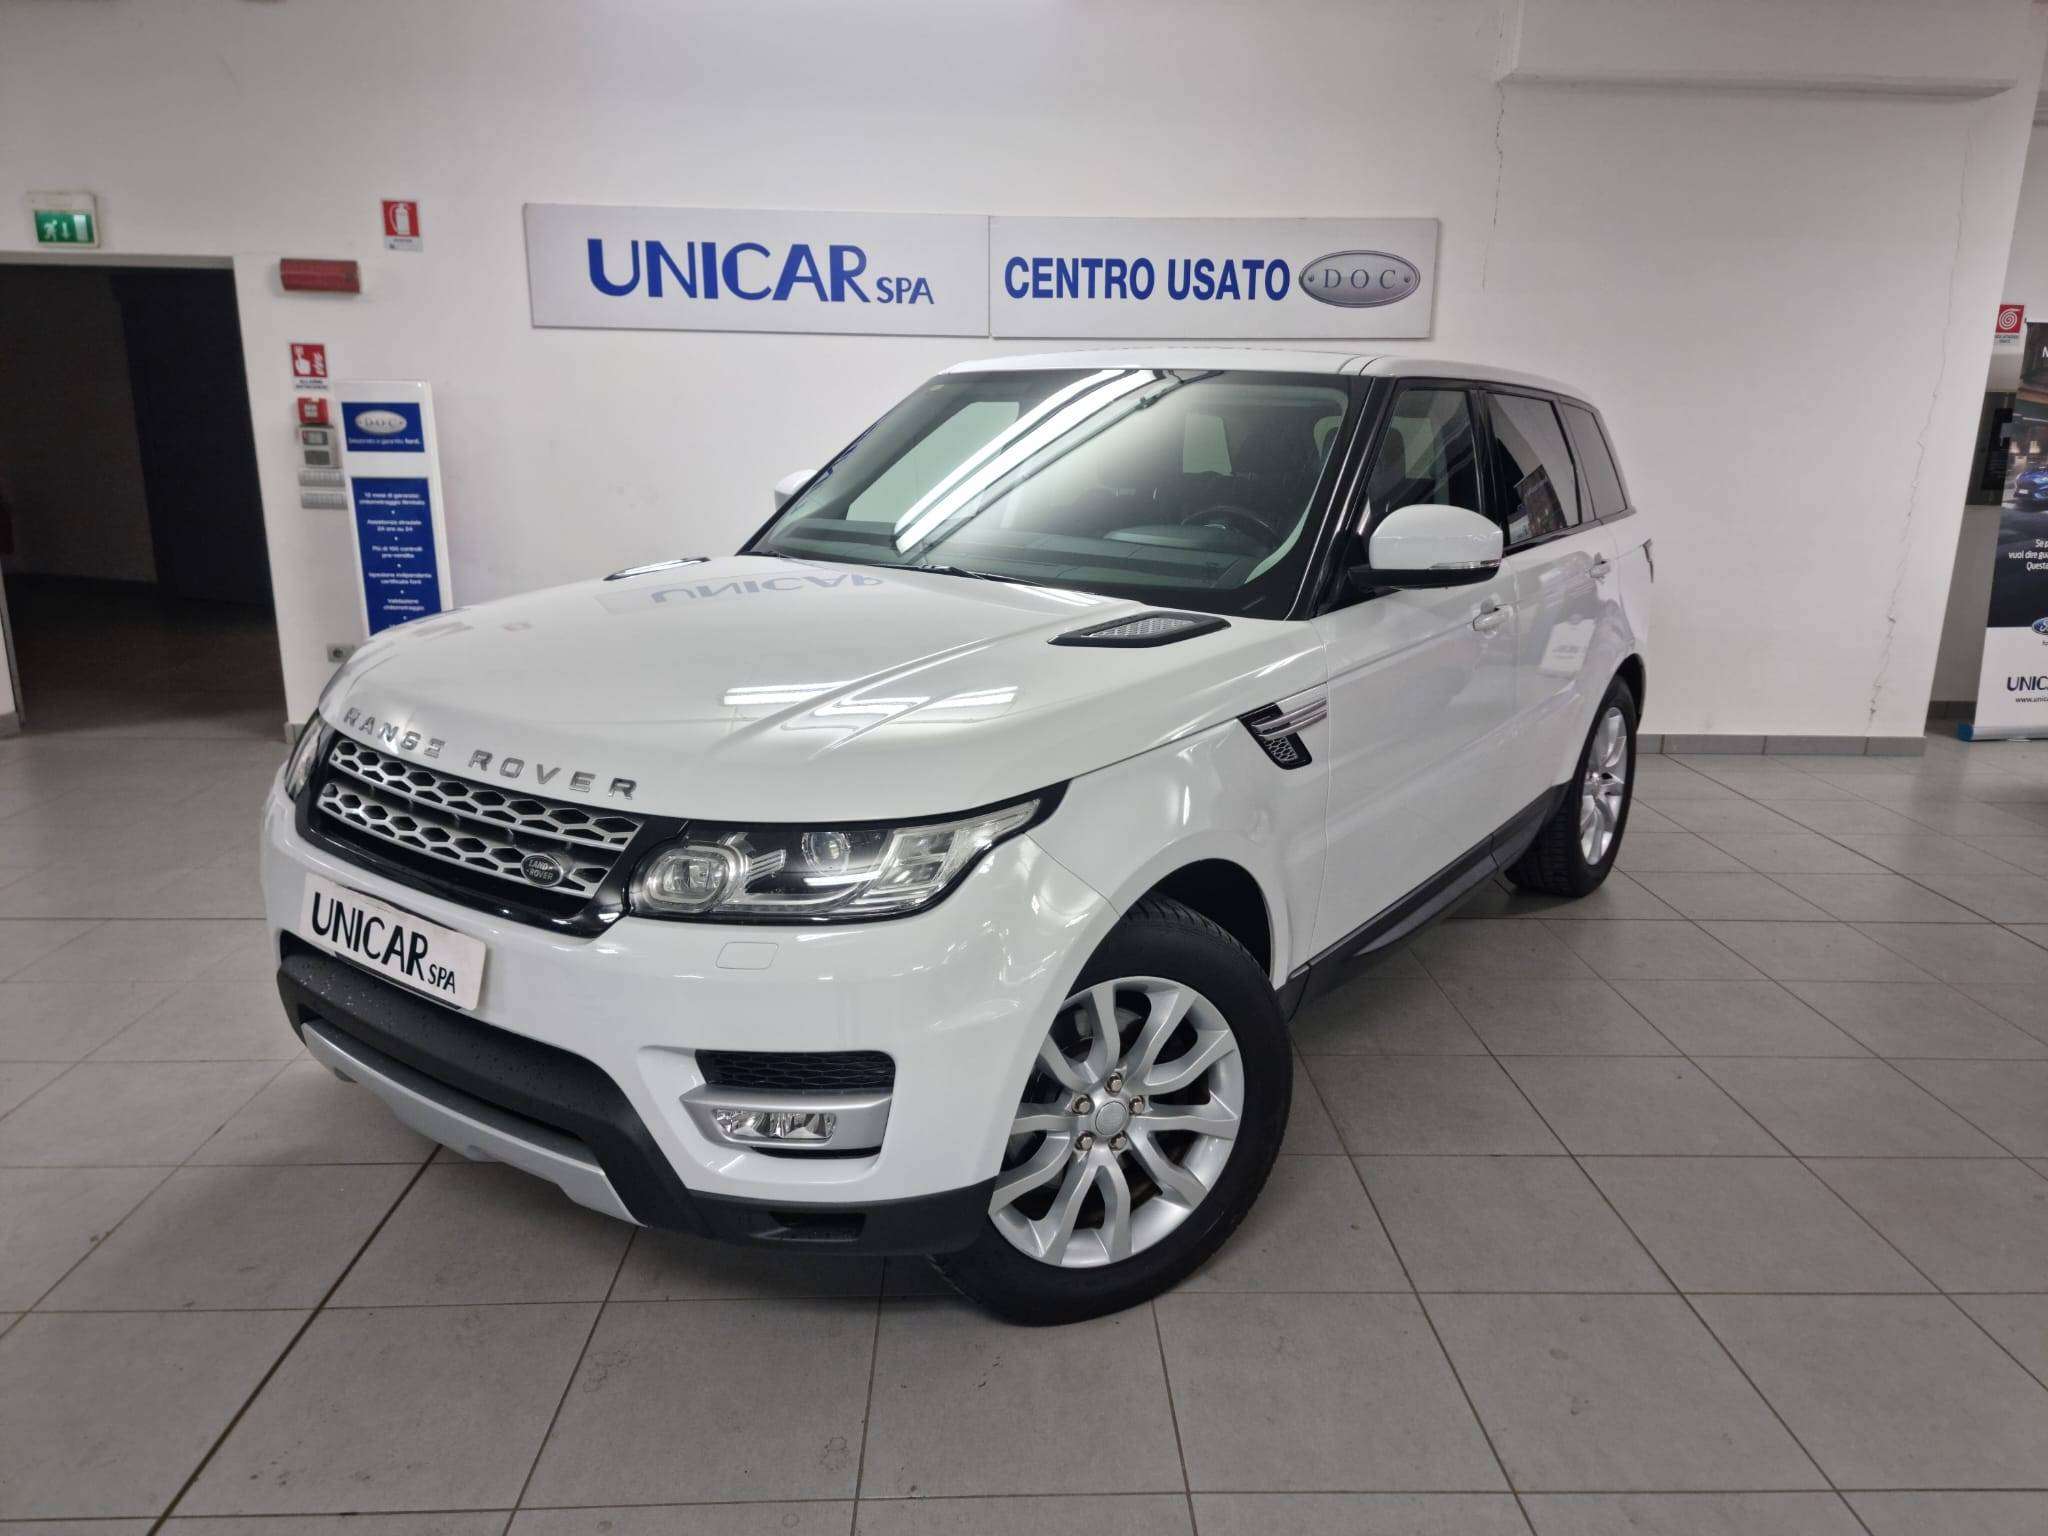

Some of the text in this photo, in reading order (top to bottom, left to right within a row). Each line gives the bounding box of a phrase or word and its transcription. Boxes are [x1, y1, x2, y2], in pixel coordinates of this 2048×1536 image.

[587, 238, 934, 305] UNICAR SPA
[1004, 256, 1290, 301] CENTRO USATO
[1323, 268, 1396, 290] DOC
[2007, 676, 2048, 691] UNIC
[343, 707, 637, 801] RANGE ROVER
[528, 859, 549, 871] LAND
[529, 867, 554, 881] ROVER
[311, 891, 456, 994] UNICAR SPA
